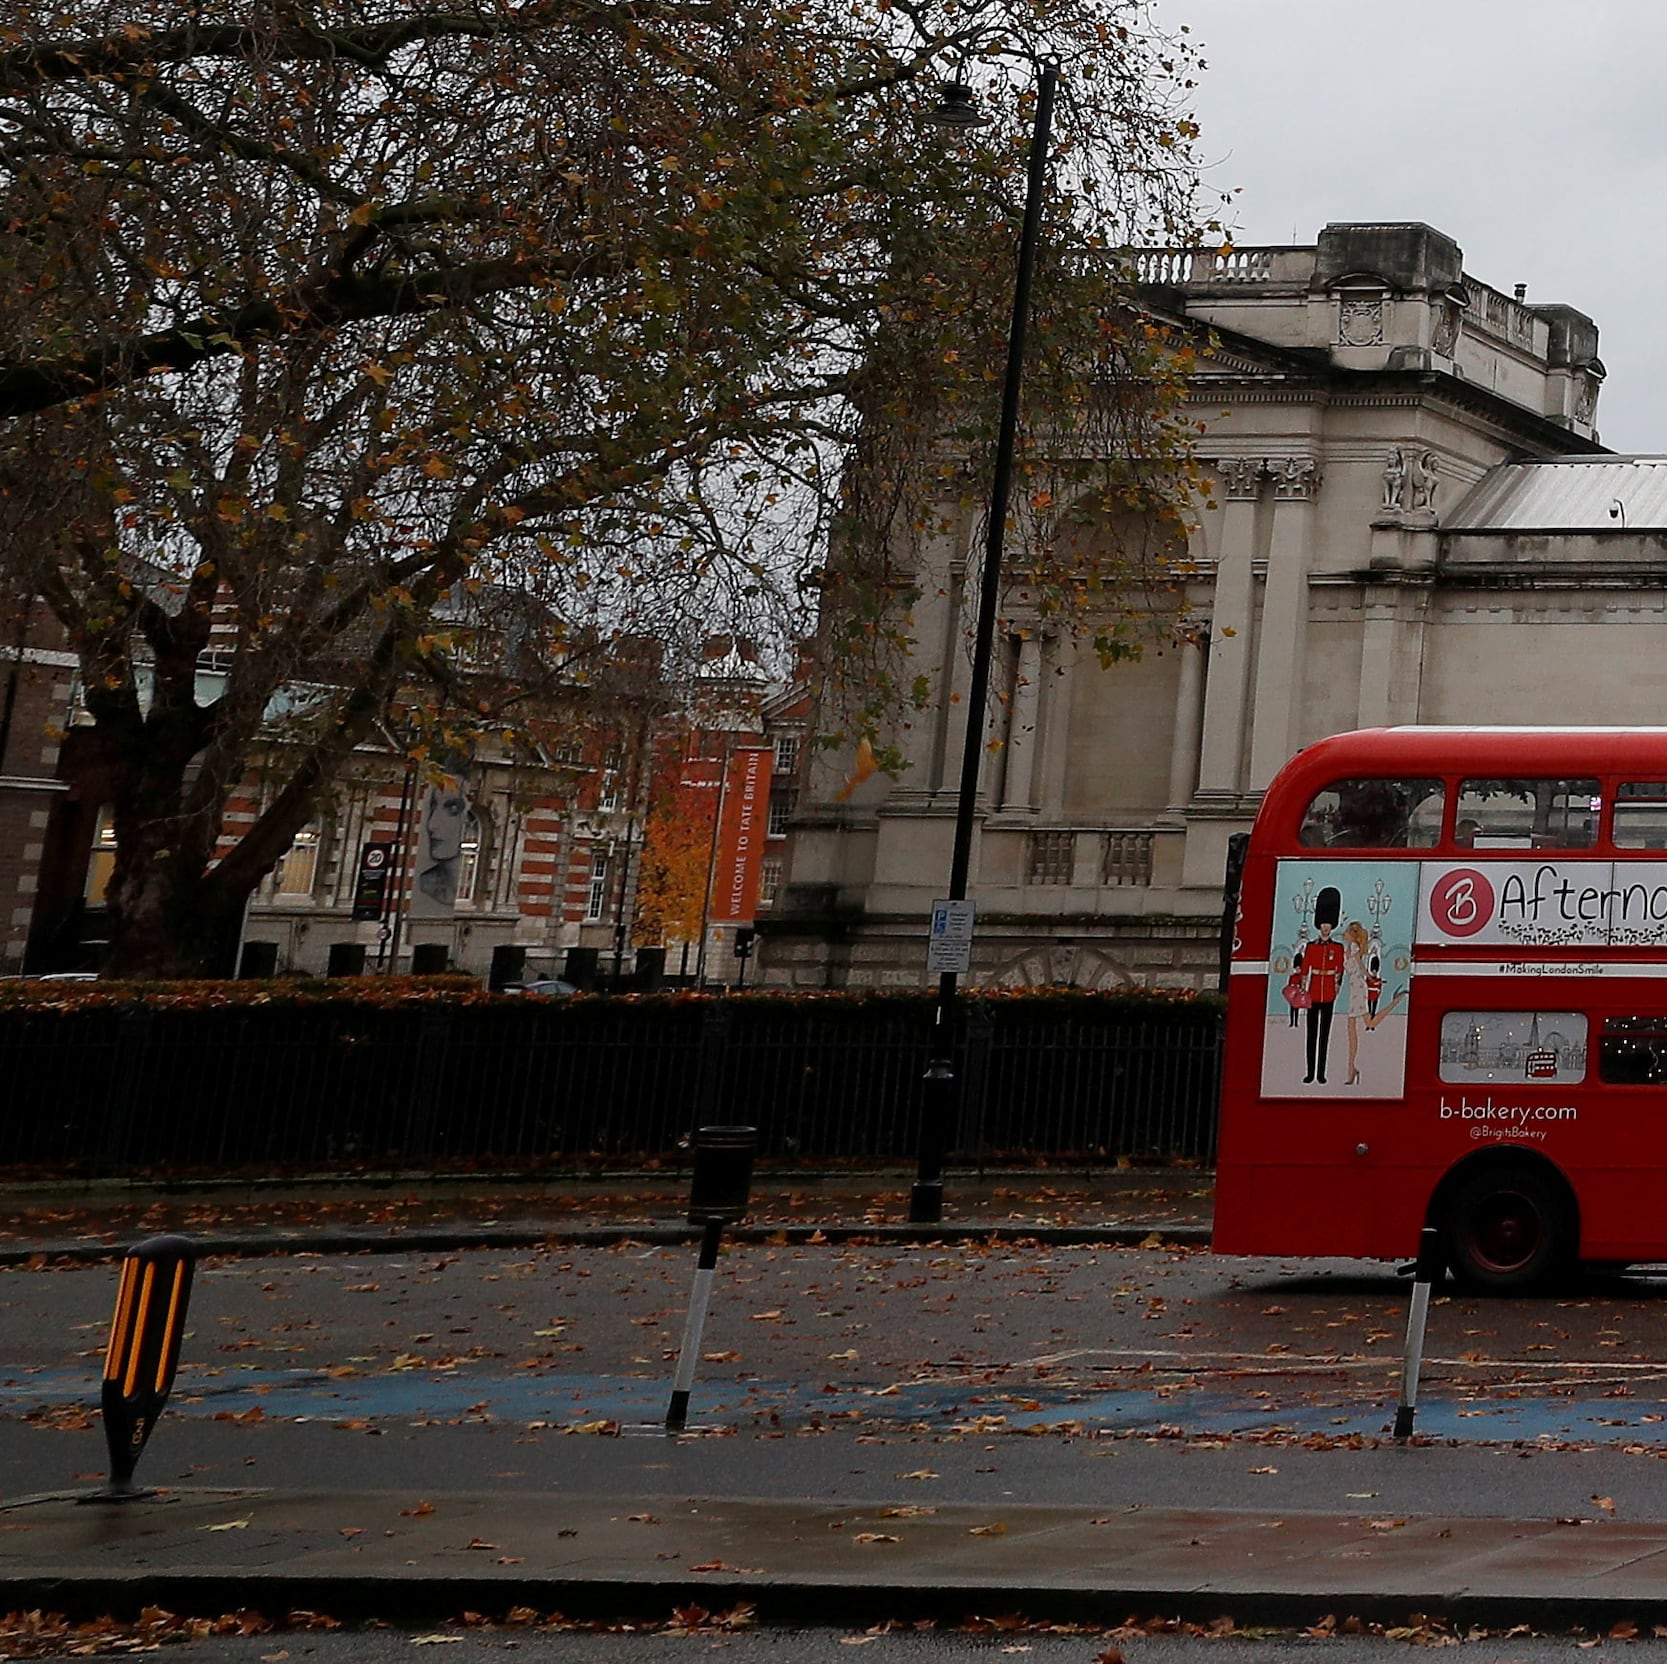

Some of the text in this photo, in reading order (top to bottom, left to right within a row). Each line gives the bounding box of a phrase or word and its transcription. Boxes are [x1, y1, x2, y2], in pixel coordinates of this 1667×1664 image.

[730, 751, 760, 916] WELCOME TO TATE BRITAIN
[369, 853, 382, 864] 20
[1499, 963, 1604, 977] #MakingLondonSmile
[1440, 1097, 1577, 1126] b-bakery.com
[1470, 1125, 1547, 1142] @BrigitsBakery
